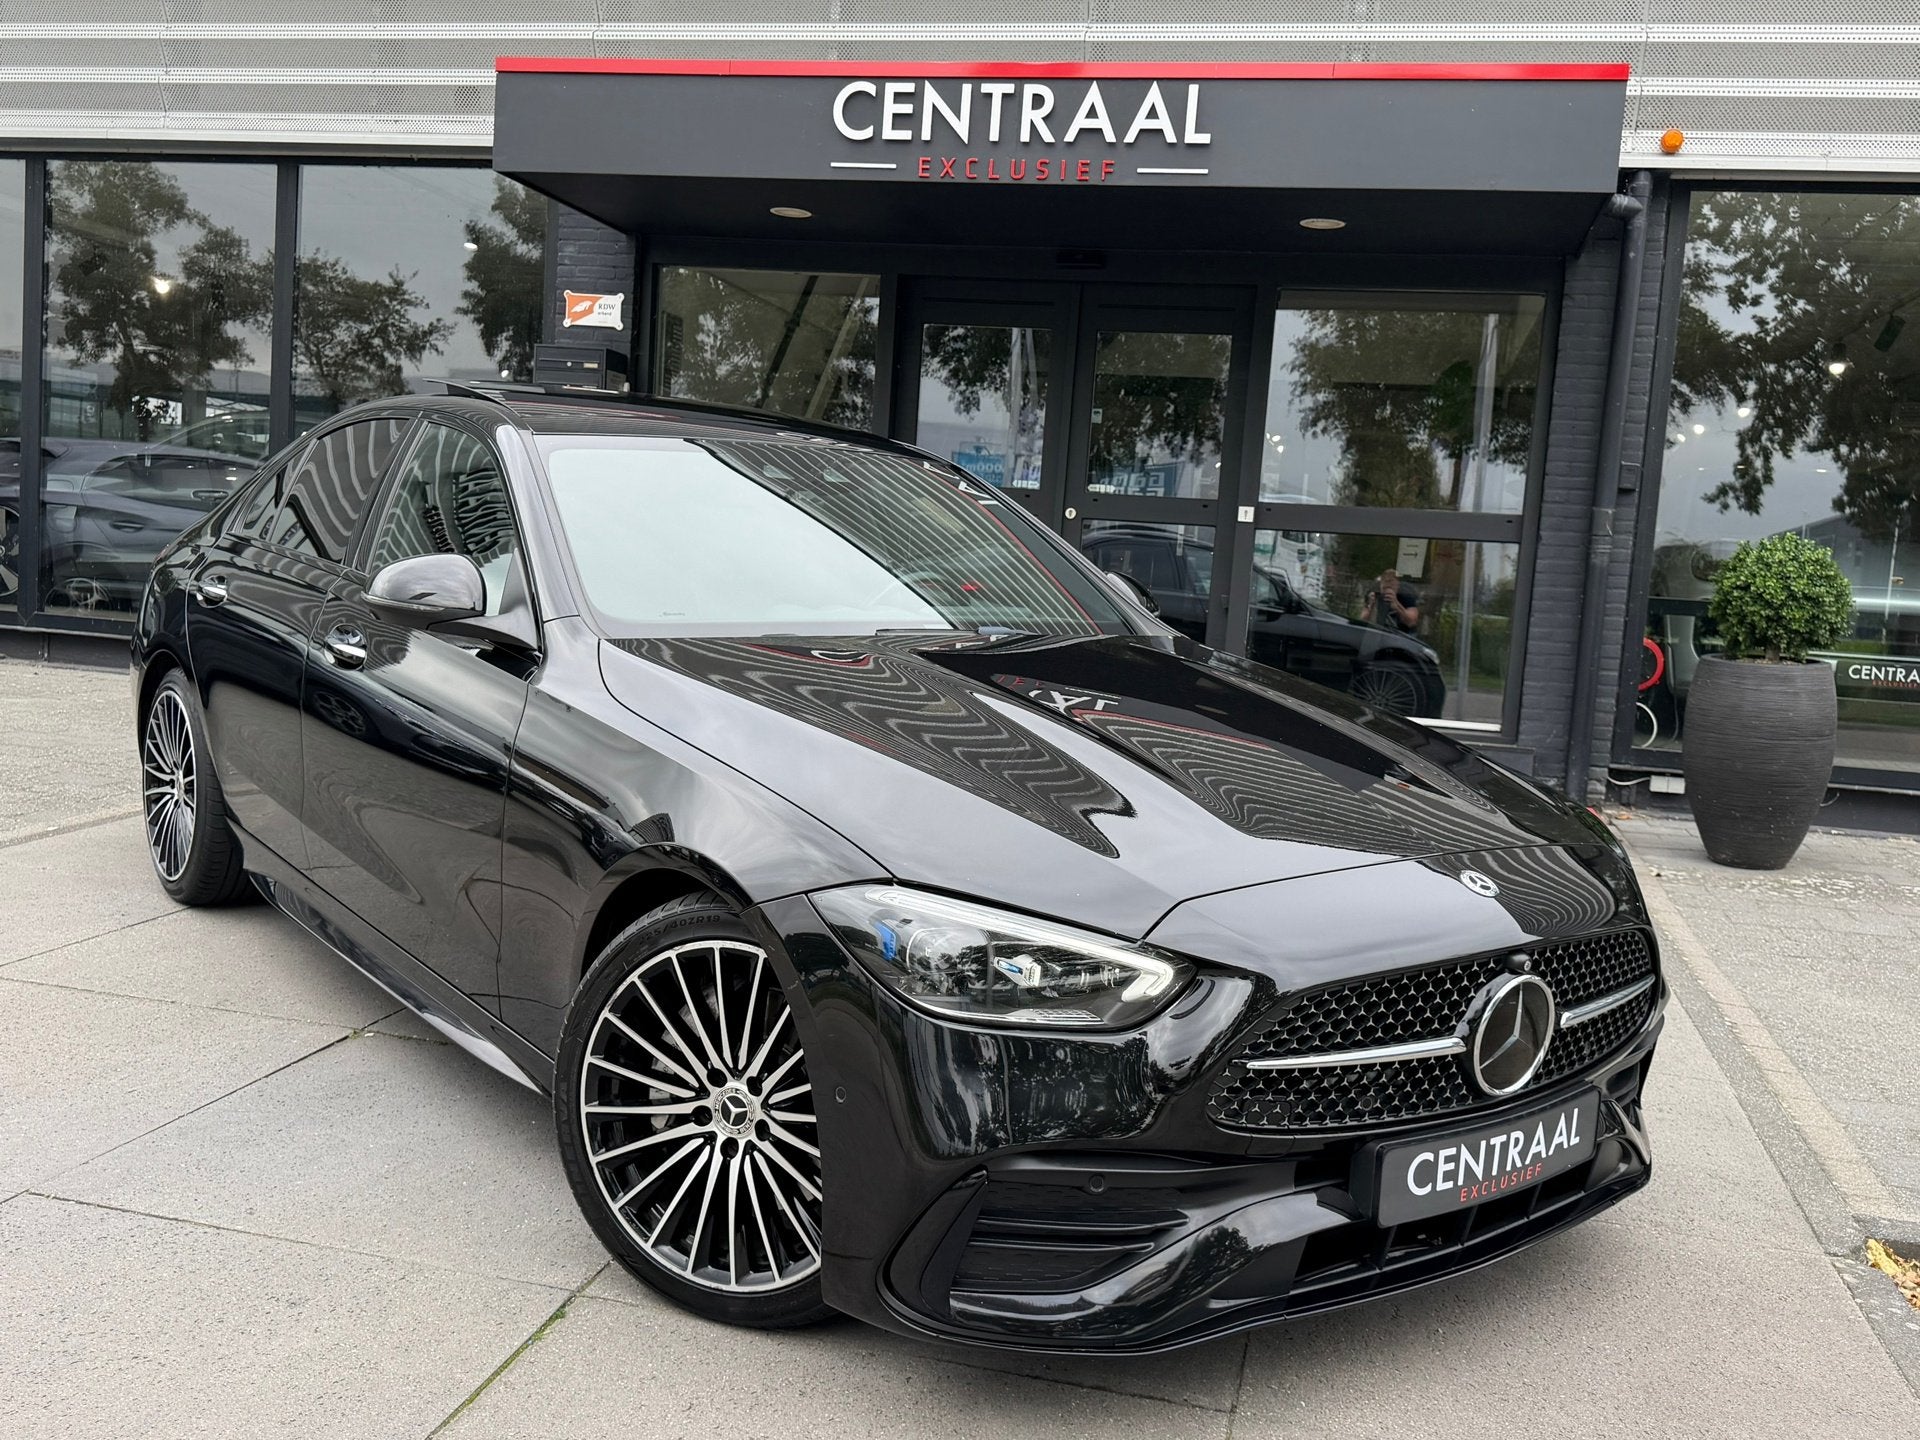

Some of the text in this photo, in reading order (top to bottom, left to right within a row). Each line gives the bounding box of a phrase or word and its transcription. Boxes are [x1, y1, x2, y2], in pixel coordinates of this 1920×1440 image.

[832, 80, 1211, 144] CENTRAAL
[917, 157, 1116, 181] EXCLUSIEF
[1848, 664, 1920, 683] CENTRA
[1407, 1107, 1580, 1196] CENTRAAL
[1459, 1162, 1543, 1202] EXCLUSIEF
